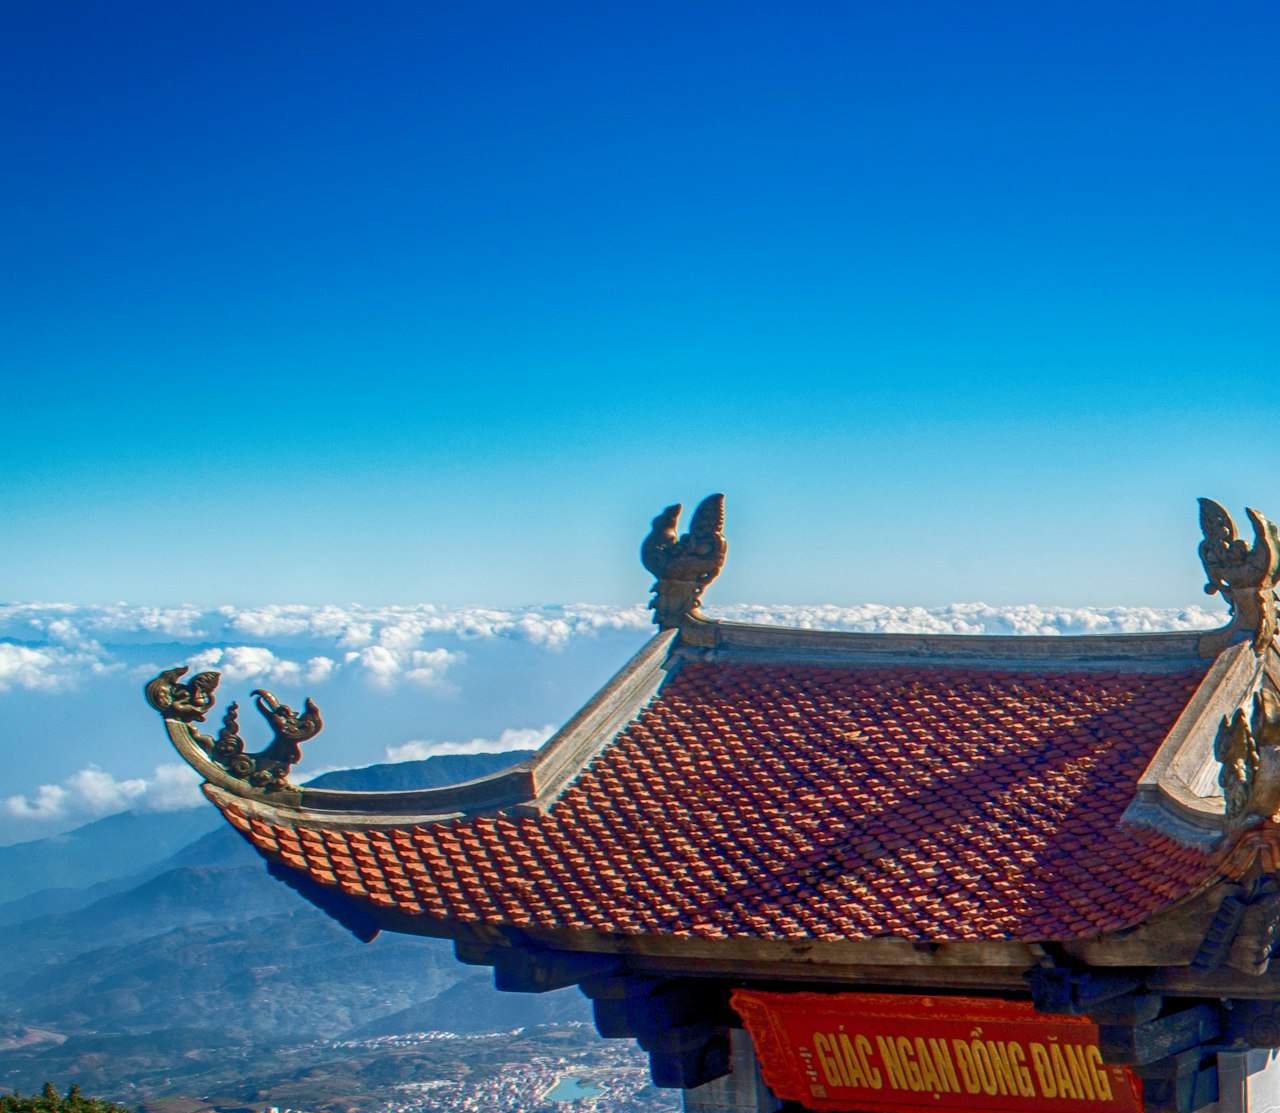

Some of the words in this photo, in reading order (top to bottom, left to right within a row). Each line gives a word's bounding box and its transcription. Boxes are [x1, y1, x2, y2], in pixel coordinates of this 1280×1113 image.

[813, 1025, 883, 1090] GIÁC
[876, 1035, 961, 1100] NGẠN
[952, 1027, 1036, 1098] ĐỒNG
[1029, 1035, 1114, 1101] ĐĂNG
